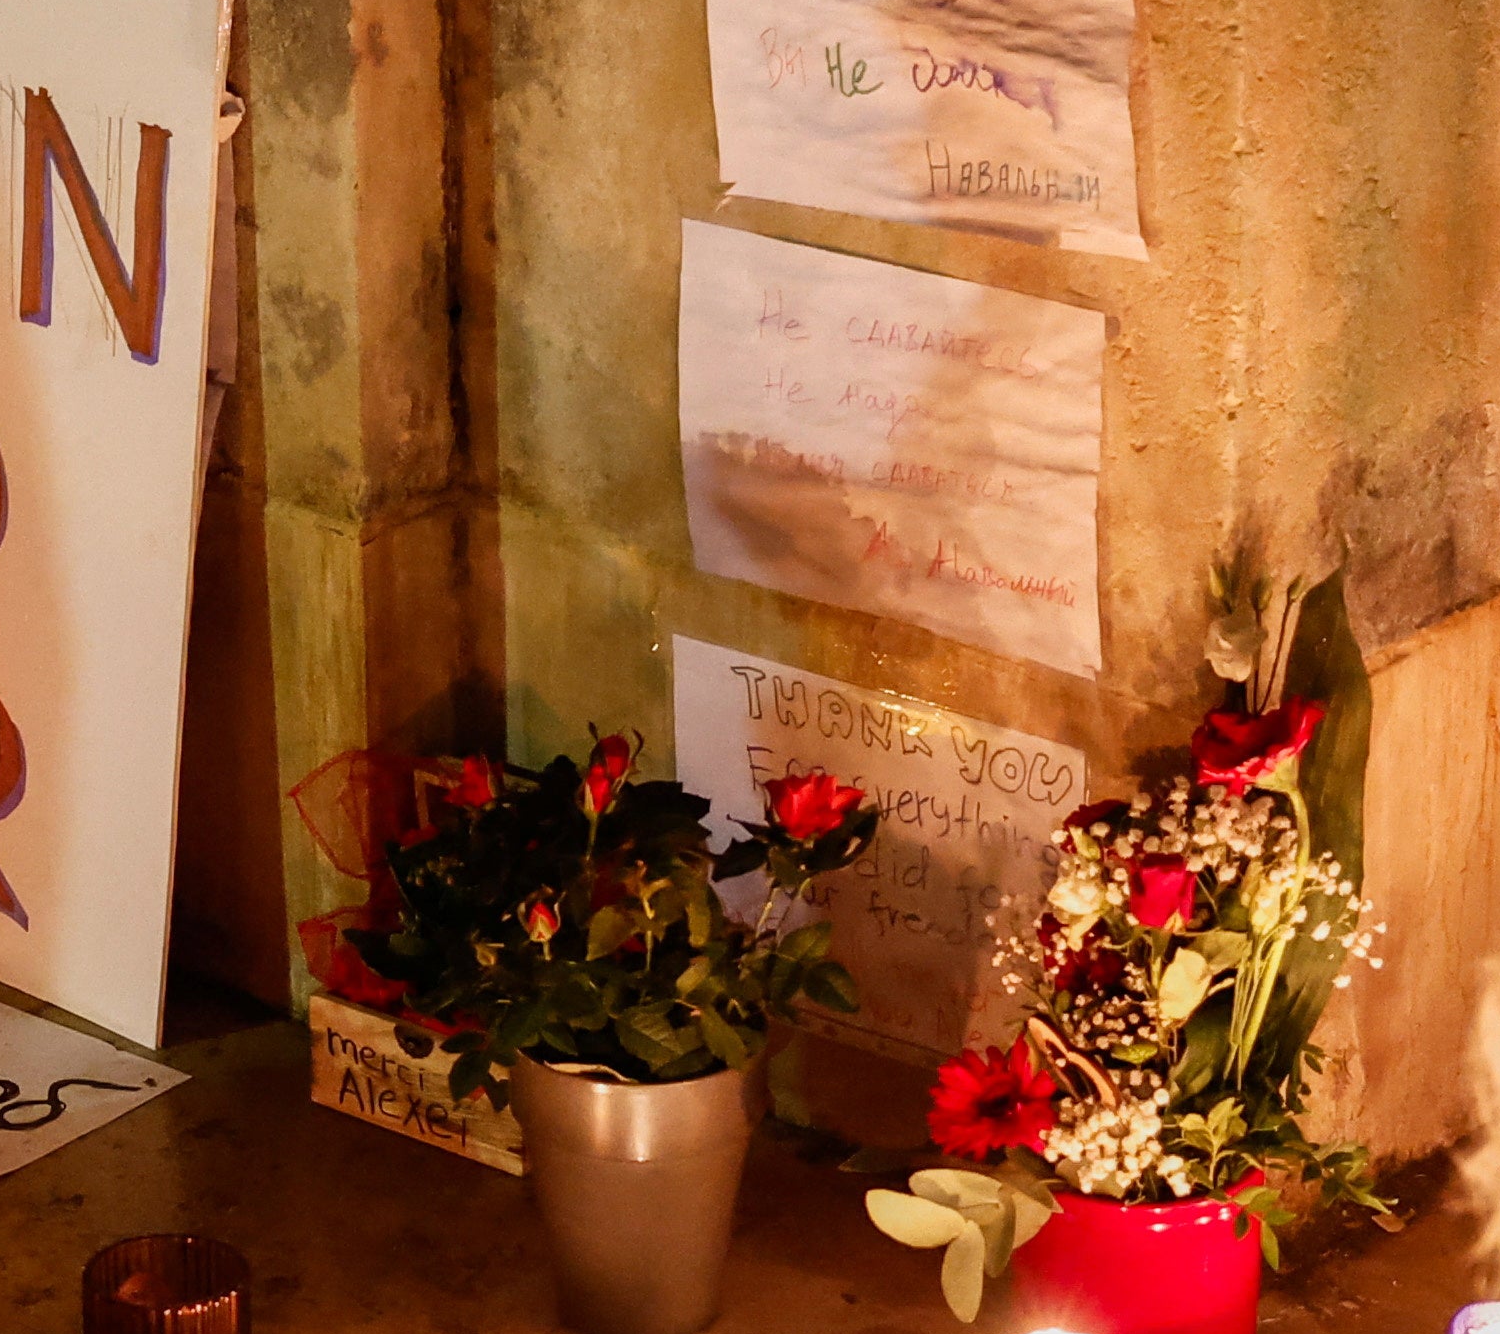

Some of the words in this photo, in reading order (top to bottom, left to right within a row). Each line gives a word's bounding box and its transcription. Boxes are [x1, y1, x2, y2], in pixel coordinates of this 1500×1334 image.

[824, 41, 885, 100] Не
[756, 287, 811, 343] Не
[764, 367, 814, 406] Не
[730, 665, 933, 757] THANK
[951, 725, 1074, 807] YOU
[853, 775, 1062, 889] verything
[853, 835, 931, 891] did
[954, 865, 1004, 931] fo
[326, 1025, 426, 1093] merci
